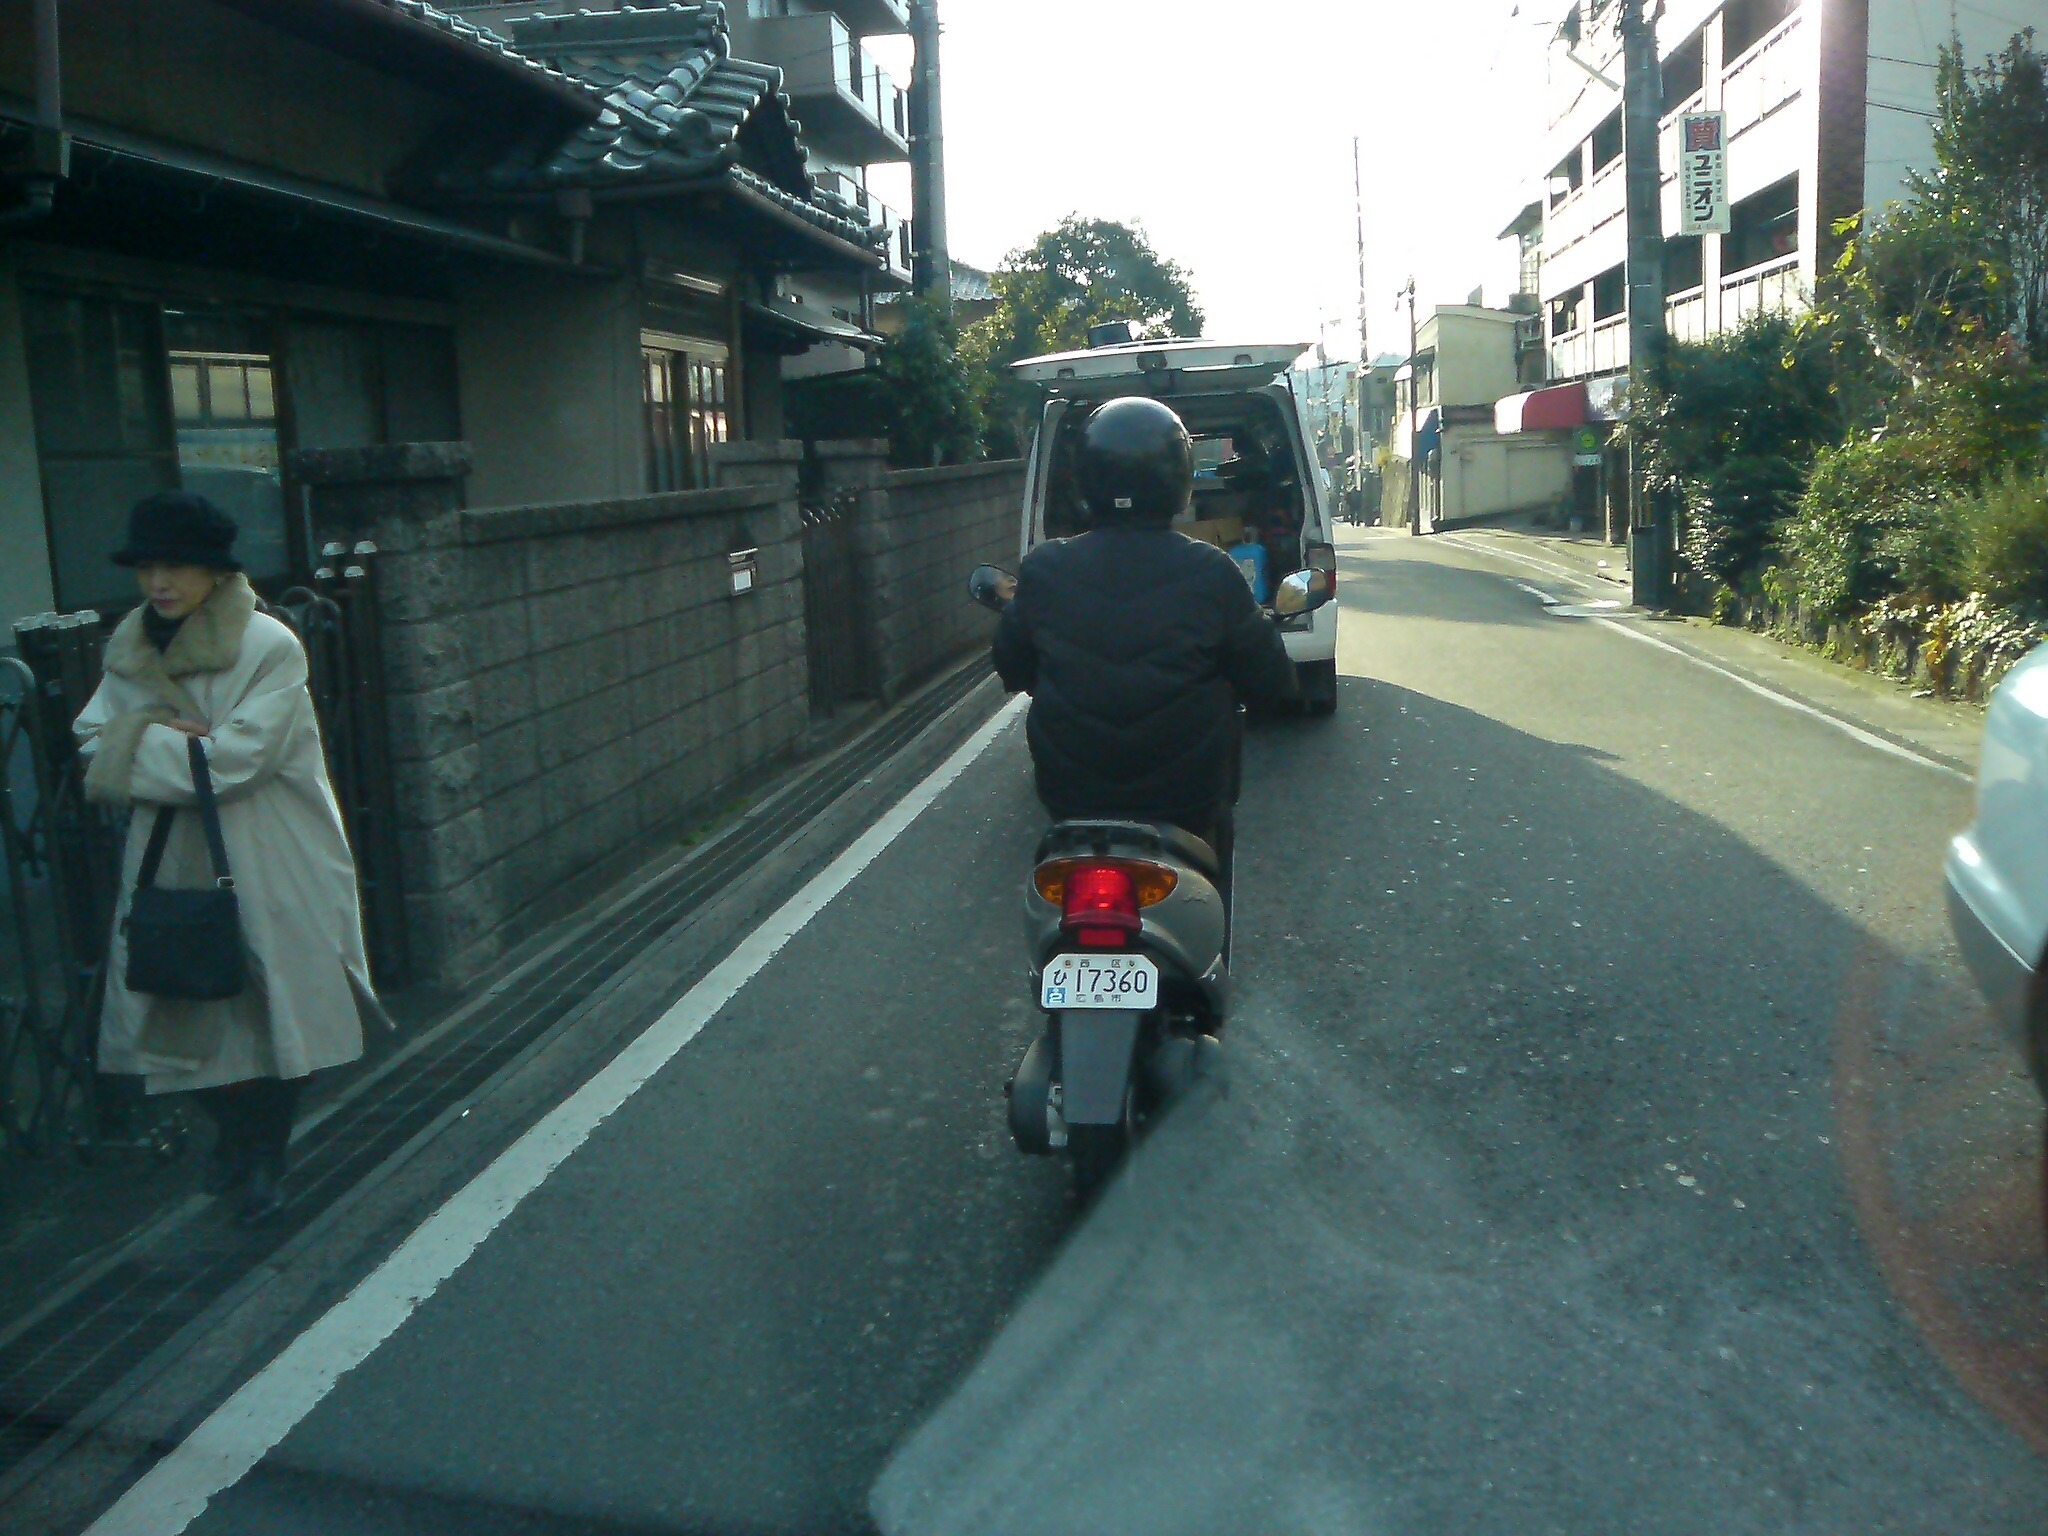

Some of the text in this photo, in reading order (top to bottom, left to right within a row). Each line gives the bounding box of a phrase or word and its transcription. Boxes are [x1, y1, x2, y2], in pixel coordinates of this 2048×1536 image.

[1693, 154, 1714, 222] ユニオン
[1053, 969, 1148, 993] ひ 17360
